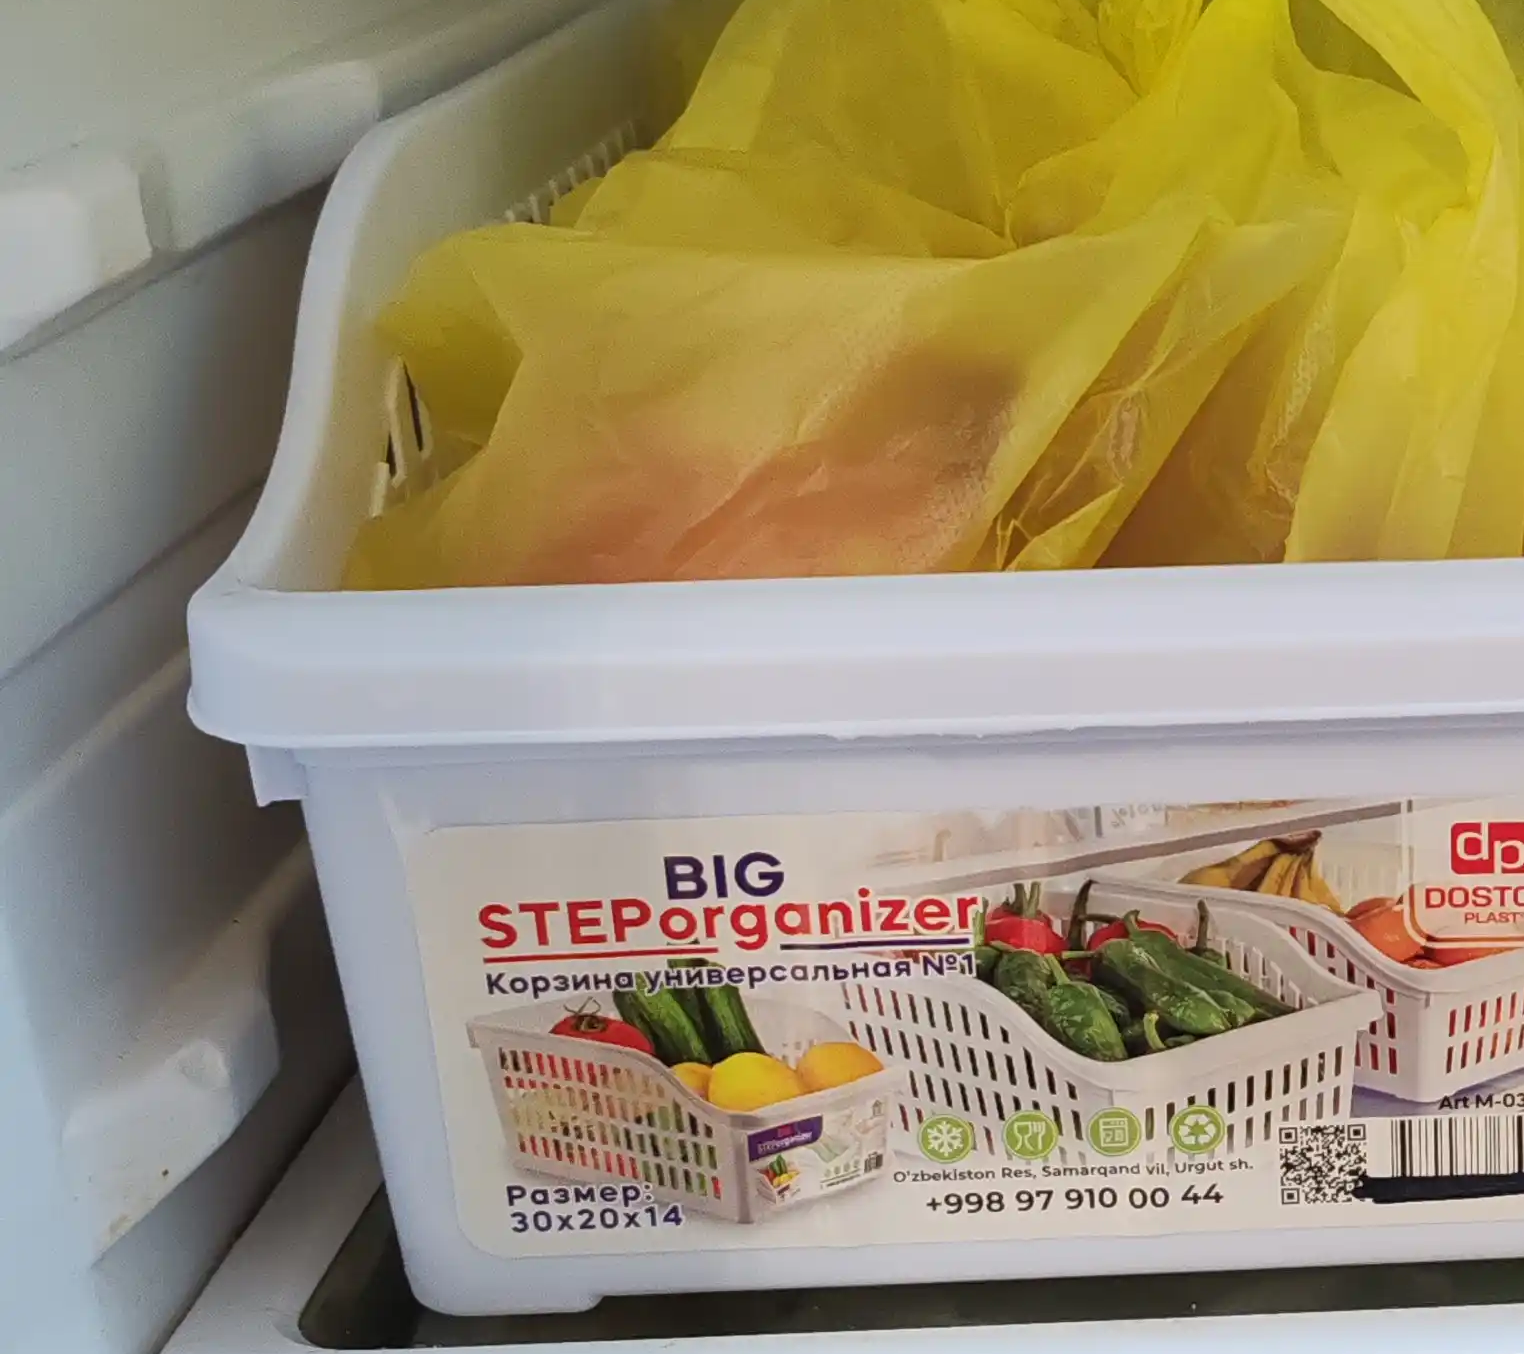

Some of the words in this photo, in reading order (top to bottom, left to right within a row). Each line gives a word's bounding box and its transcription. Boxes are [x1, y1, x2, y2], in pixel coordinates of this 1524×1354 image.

[663, 851, 785, 900] BIG
[1464, 911, 1522, 925] PLAST
[485, 970, 634, 999] Корзина
[644, 959, 912, 994] универсальная
[922, 952, 975, 977] №1
[1438, 1095, 1470, 1111] Art
[893, 1167, 996, 1184] O'zbekiston
[1001, 1165, 1037, 1181] Res,
[1041, 1162, 1141, 1179] Samarqand
[1145, 1161, 1171, 1178] vil,
[1175, 1159, 1225, 1177] Urgut
[1228, 1158, 1255, 1172] sh.
[506, 1181, 654, 1209] Размер:
[925, 1191, 1006, 1215] +998
[1015, 1189, 1054, 1212] 97
[1064, 1186, 1118, 1210] 910
[1127, 1185, 1170, 1209] 00
[1180, 1182, 1225, 1205] 44
